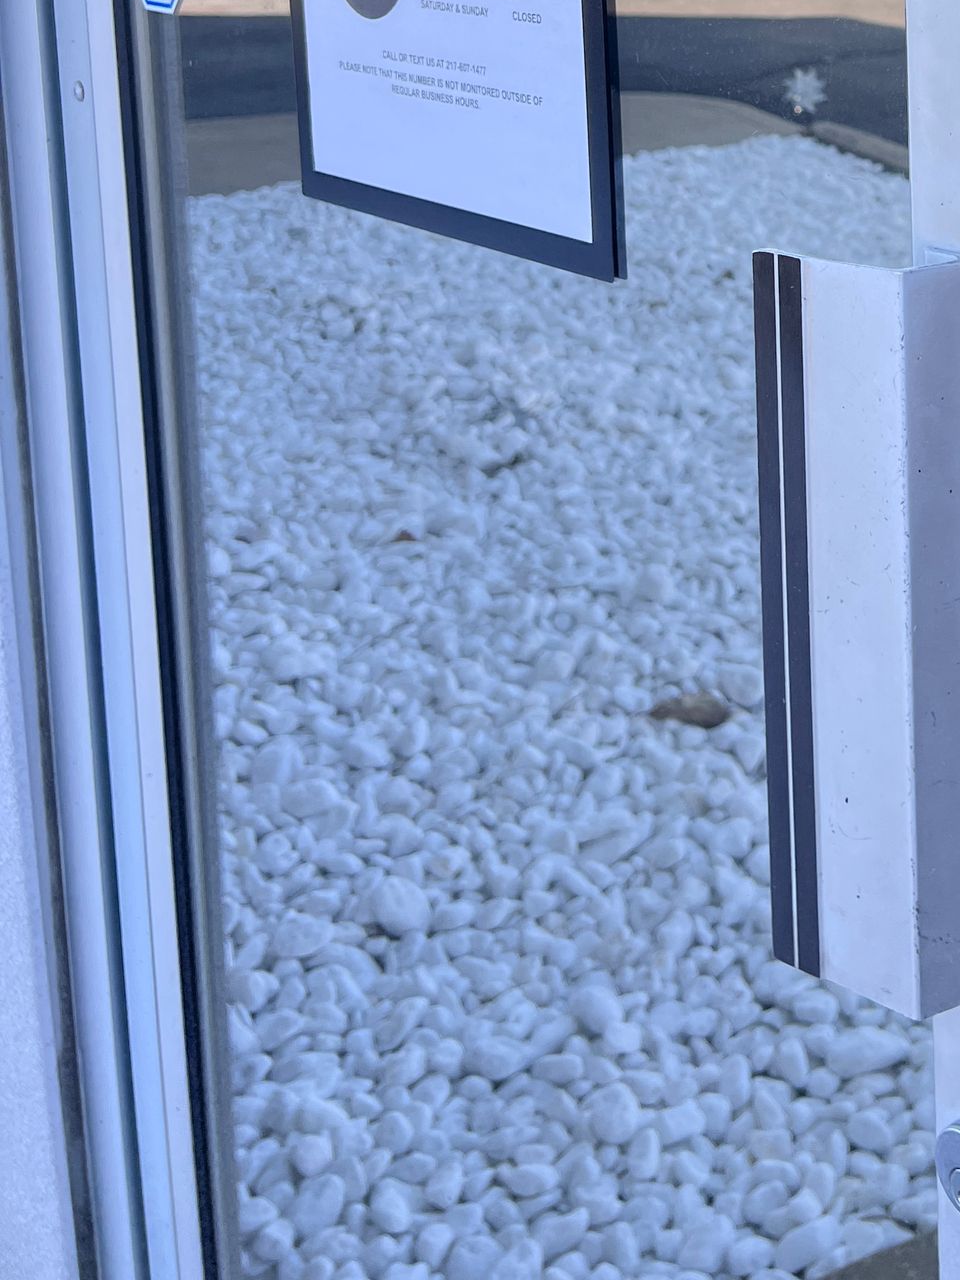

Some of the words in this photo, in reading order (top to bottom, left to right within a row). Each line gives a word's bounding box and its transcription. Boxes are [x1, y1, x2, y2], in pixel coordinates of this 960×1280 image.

[421, 0, 454, 13] SATURDAY
[461, 4, 489, 17] SUNDAY
[512, 11, 542, 24] CLOSED
[382, 50, 397, 61] CALL
[399, 53, 408, 62] OR
[408, 54, 424, 65] TEXT
[426, 57, 435, 67] US
[436, 59, 444, 68] AT
[339, 60, 361, 72] PLEASE
[363, 65, 378, 76] NOTE
[379, 67, 393, 78] THAT
[394, 70, 408, 82] THIS
[408, 73, 435, 86] NUMBER
[437, 78, 444, 88] IS
[445, 80, 459, 90] NOT
[460, 82, 500, 98] MONITORED
[501, 90, 531, 104] OUTSIDE
[534, 95, 543, 106] OF
[391, 83, 420, 98] REGULAR
[421, 90, 453, 105] BUSINESS
